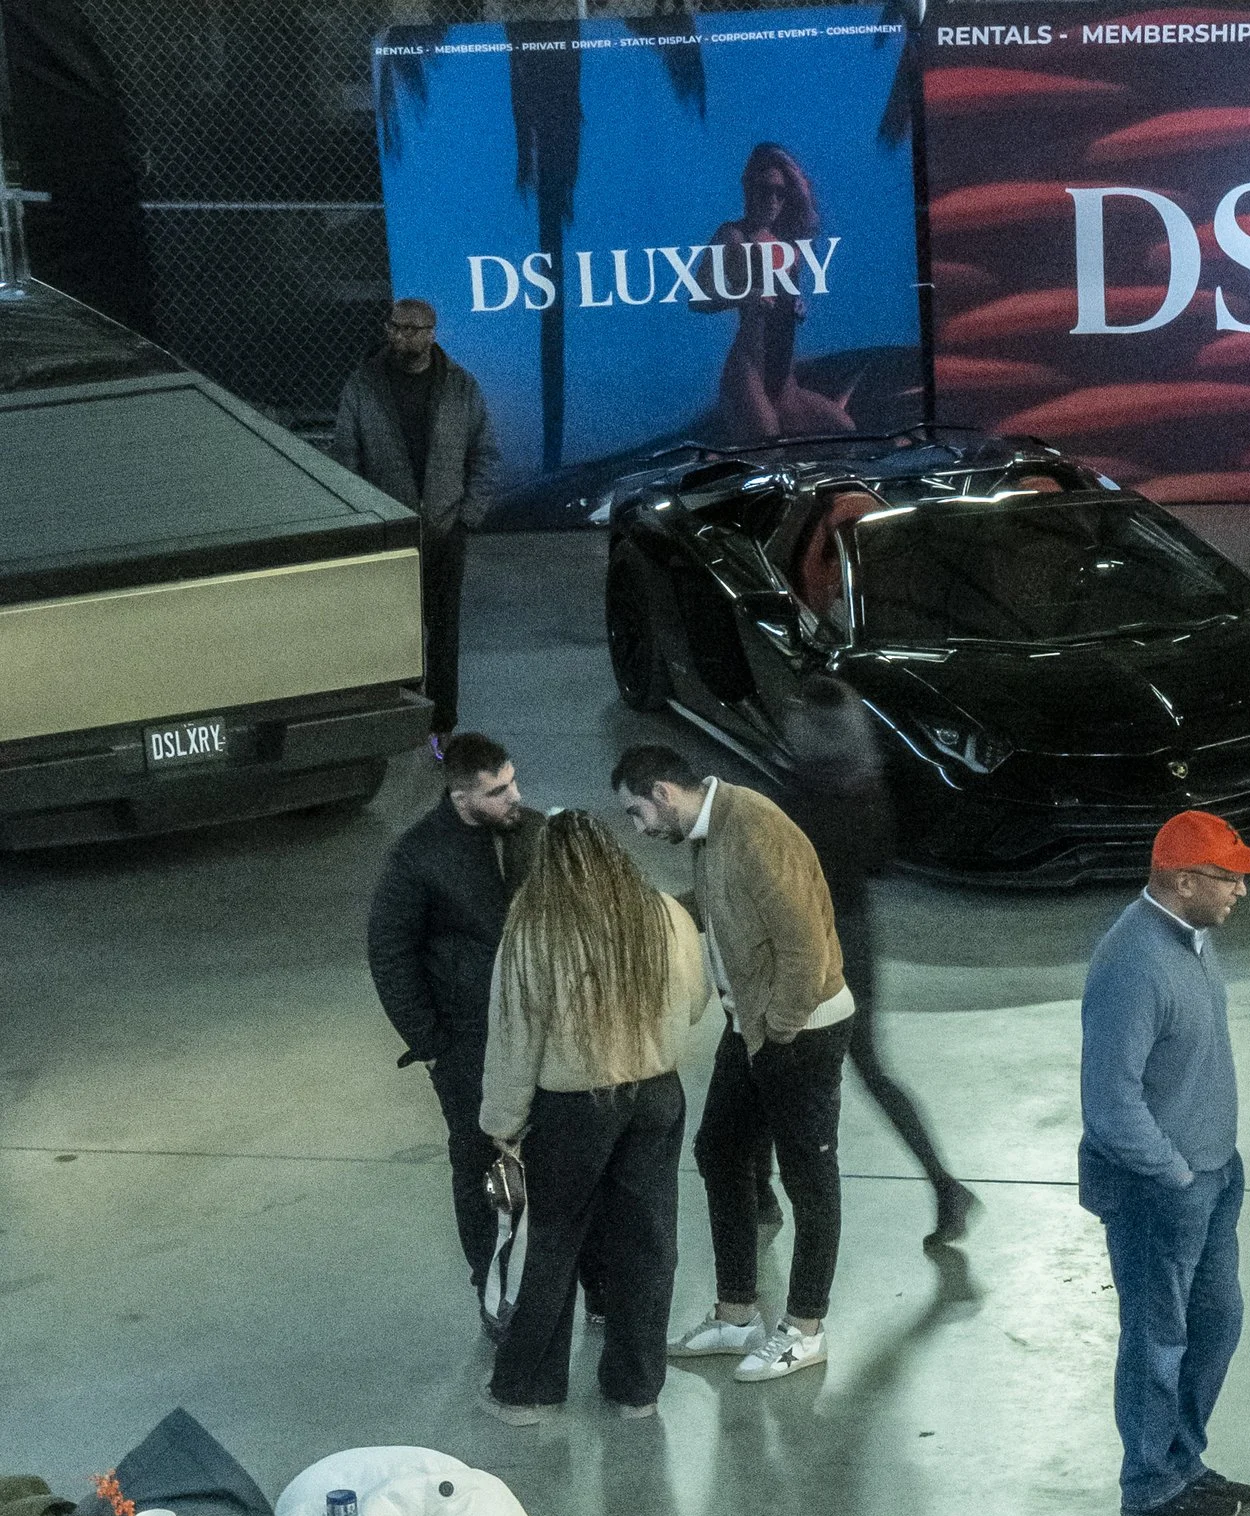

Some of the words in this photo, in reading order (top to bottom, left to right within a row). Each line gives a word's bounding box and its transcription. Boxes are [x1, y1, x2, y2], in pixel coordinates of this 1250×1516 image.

[375, 45, 423, 55] RENTALS
[435, 43, 513, 54] MEMBERSHIPS
[522, 41, 566, 51] PRIVATE
[571, 40, 611, 49] DRIVER
[620, 37, 655, 47] STATIC
[657, 34, 702, 45] DISPLAY
[711, 31, 775, 42] CORPORATE
[778, 28, 818, 39] EVENTS
[826, 24, 902, 36] CONSIGNMENT
[937, 25, 1052, 45] RENTALS
[467, 252, 556, 312] DS
[576, 237, 842, 307] LUXURY
[151, 724, 220, 760] DSLXRY
